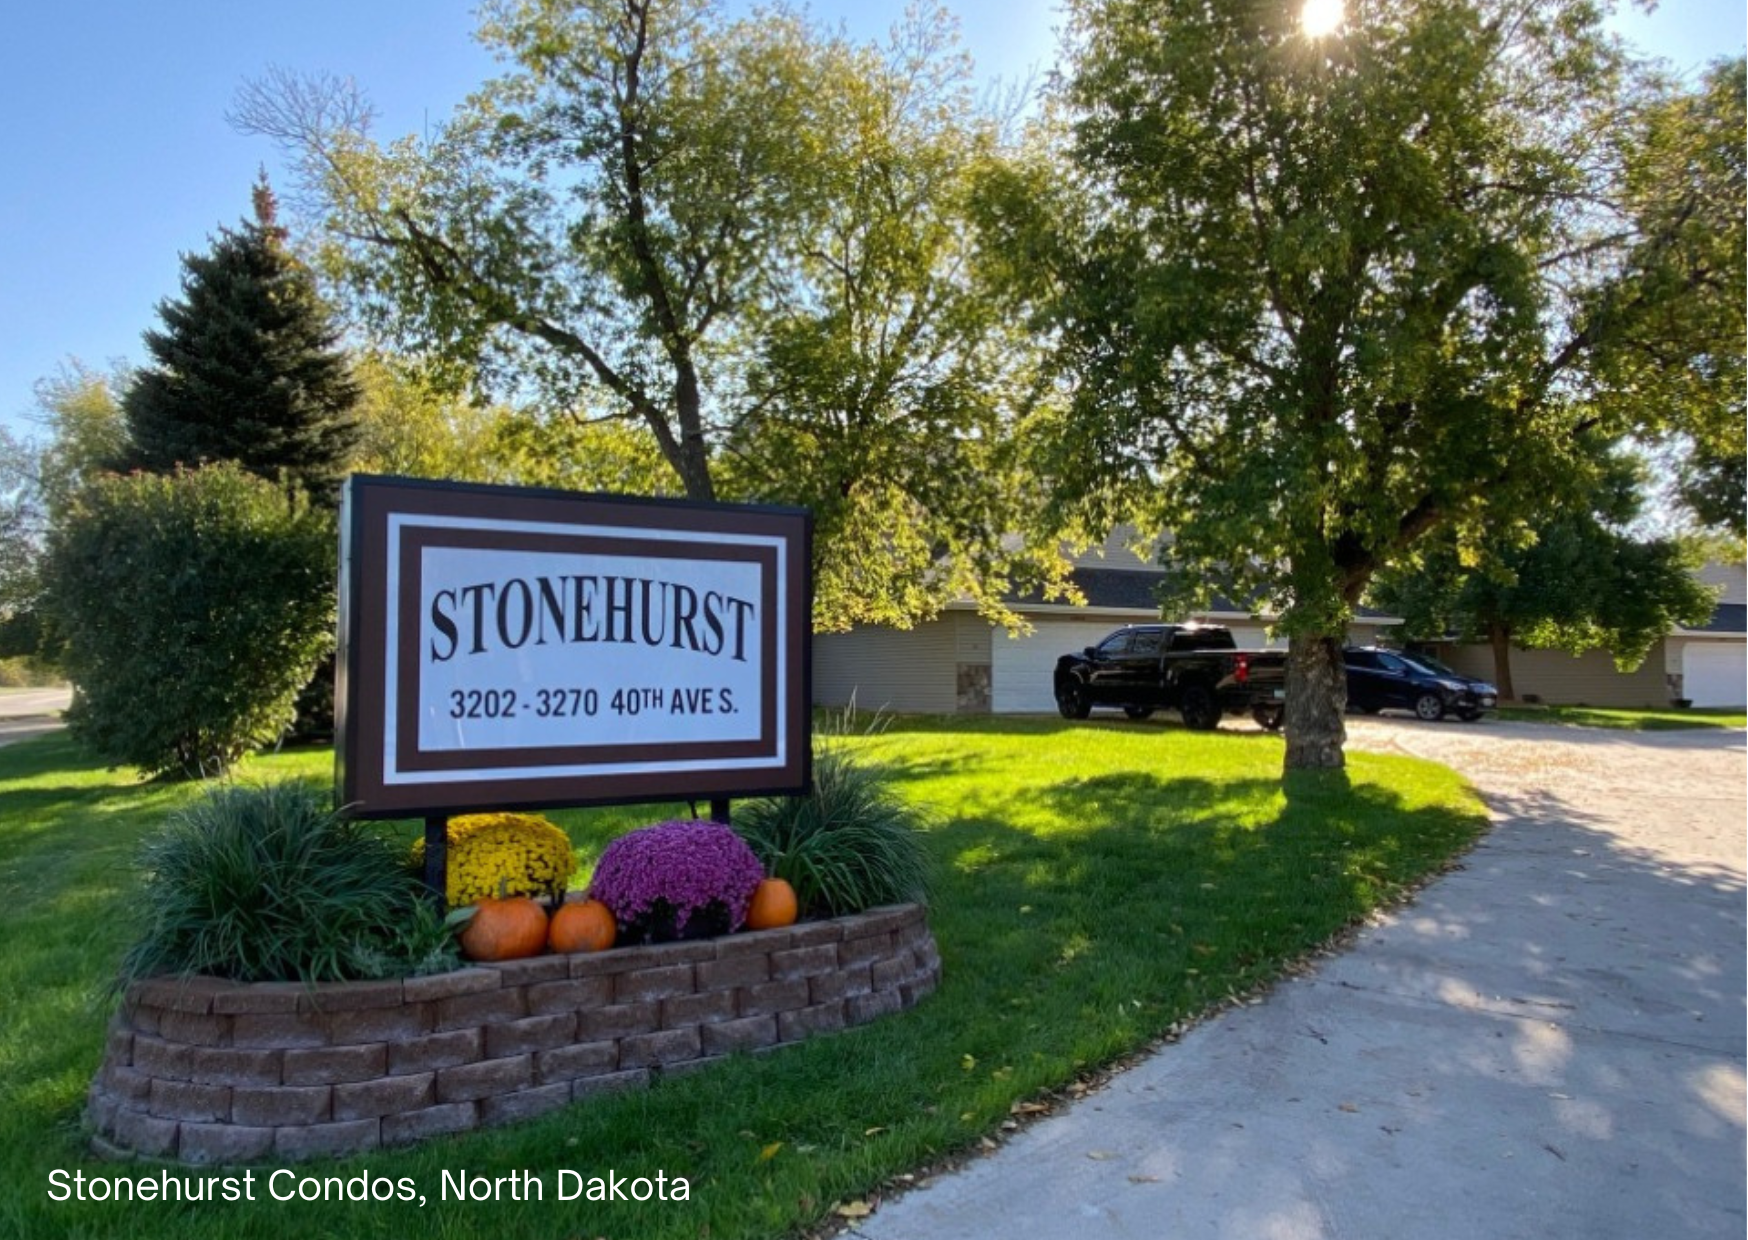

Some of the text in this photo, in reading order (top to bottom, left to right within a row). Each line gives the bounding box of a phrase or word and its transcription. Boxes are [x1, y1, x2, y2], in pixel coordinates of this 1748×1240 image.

[430, 574, 755, 663] STONEHURST
[610, 688, 664, 716] 40TH
[670, 688, 713, 714] AVE
[718, 687, 738, 714] S.
